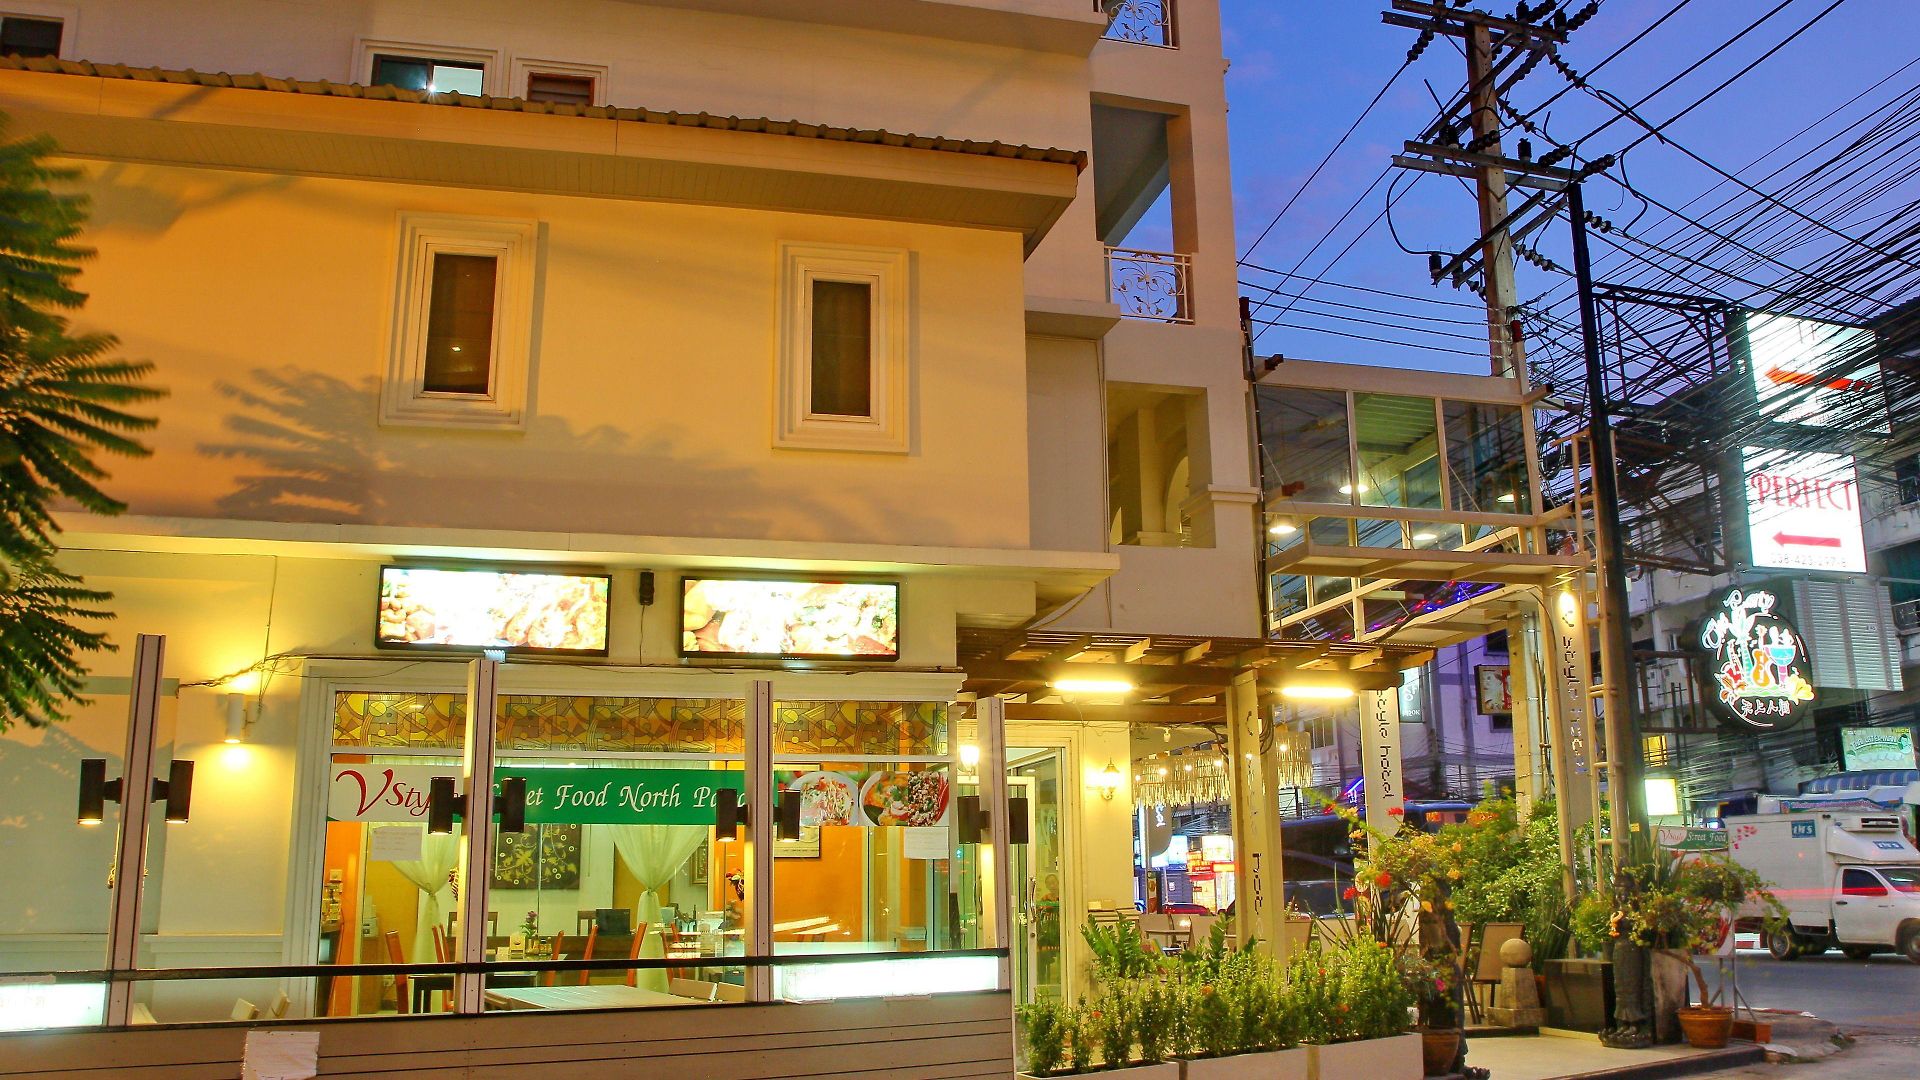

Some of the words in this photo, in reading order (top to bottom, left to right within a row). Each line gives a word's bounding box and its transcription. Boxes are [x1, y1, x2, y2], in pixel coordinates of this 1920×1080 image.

[1750, 472, 1852, 511] PERFECT
[1380, 745, 1395, 799] hotel
[553, 781, 613, 811] Food
[618, 783, 681, 813] North
[1709, 832, 1726, 843] Food
